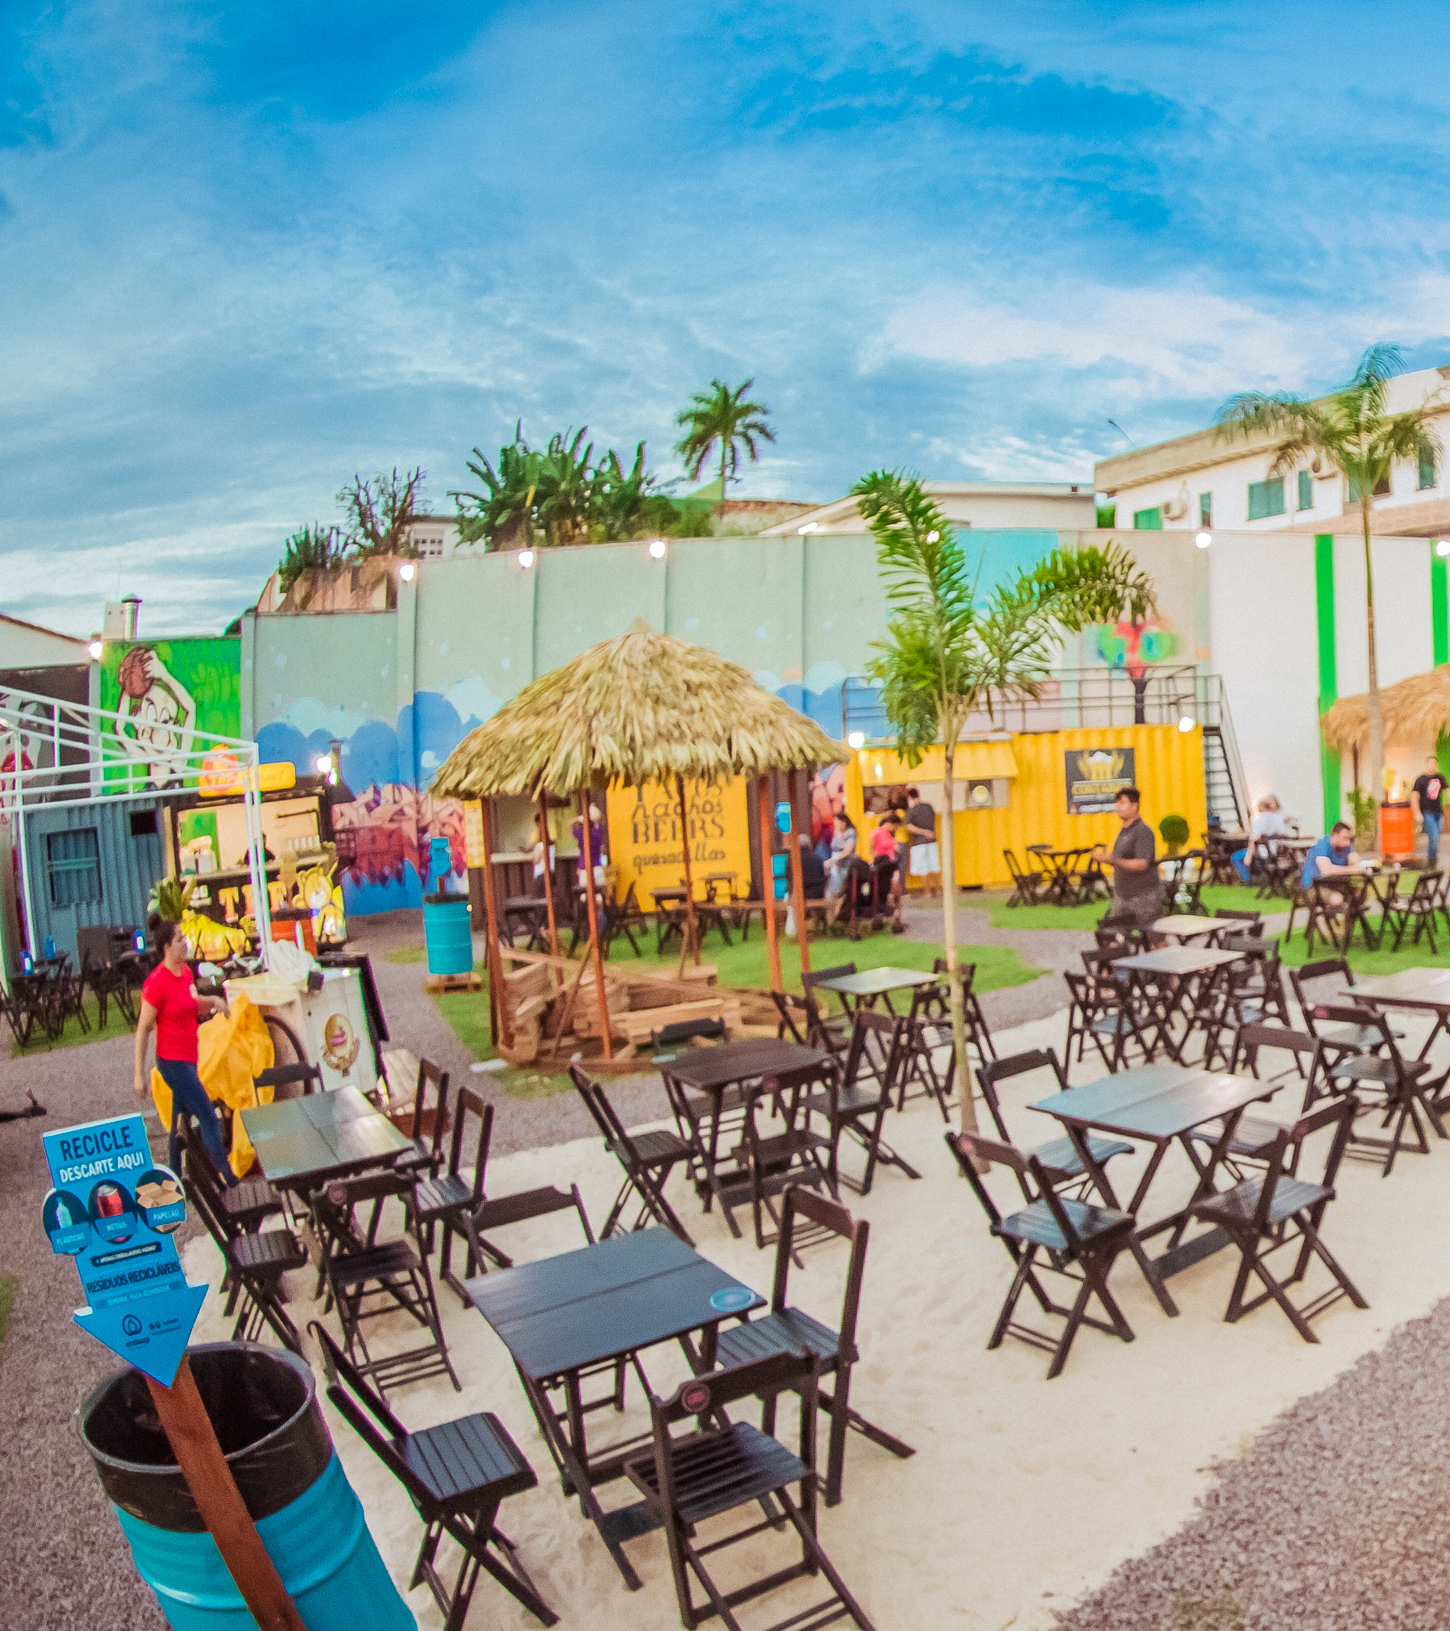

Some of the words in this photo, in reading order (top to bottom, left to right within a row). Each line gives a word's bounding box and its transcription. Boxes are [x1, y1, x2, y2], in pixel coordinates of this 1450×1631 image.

[60, 1126, 134, 1161] RECICLE
[60, 1158, 115, 1183] DESCARTE
[117, 1151, 145, 1170] AQUI
[85, 1276, 129, 1294] RESÍDUOS
